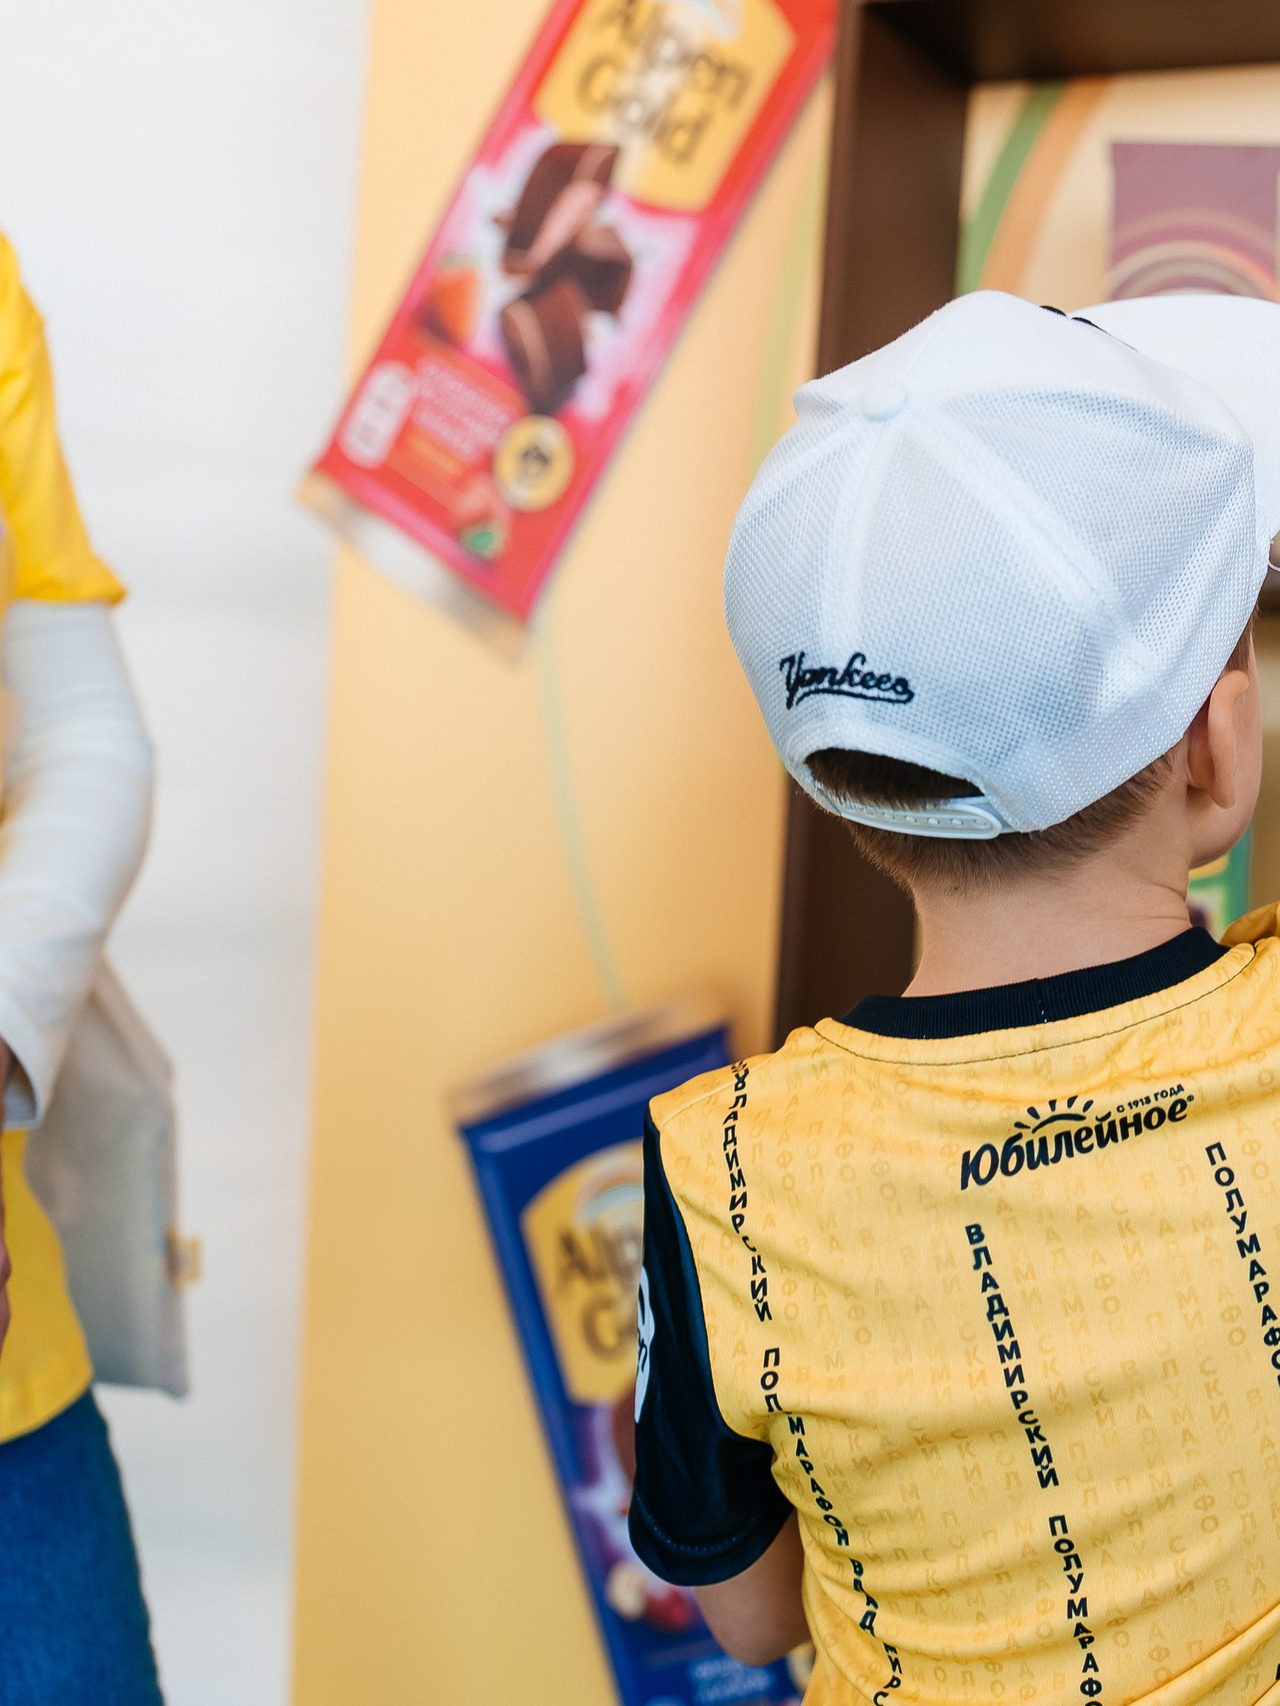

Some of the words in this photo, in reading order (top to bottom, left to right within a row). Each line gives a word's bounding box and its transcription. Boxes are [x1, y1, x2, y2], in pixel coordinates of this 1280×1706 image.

[576, 54, 714, 166] Gold
[780, 651, 915, 710] Yankees
[960, 1097, 1190, 1191] Юбилейное
[1127, 1095, 1152, 1111] 1918
[1153, 1083, 1185, 1102] ГОДА
[964, 1223, 1060, 1489] ВЛАДИМИРСКИЙ
[760, 1347, 850, 1546] ПОЛМАРАФОН
